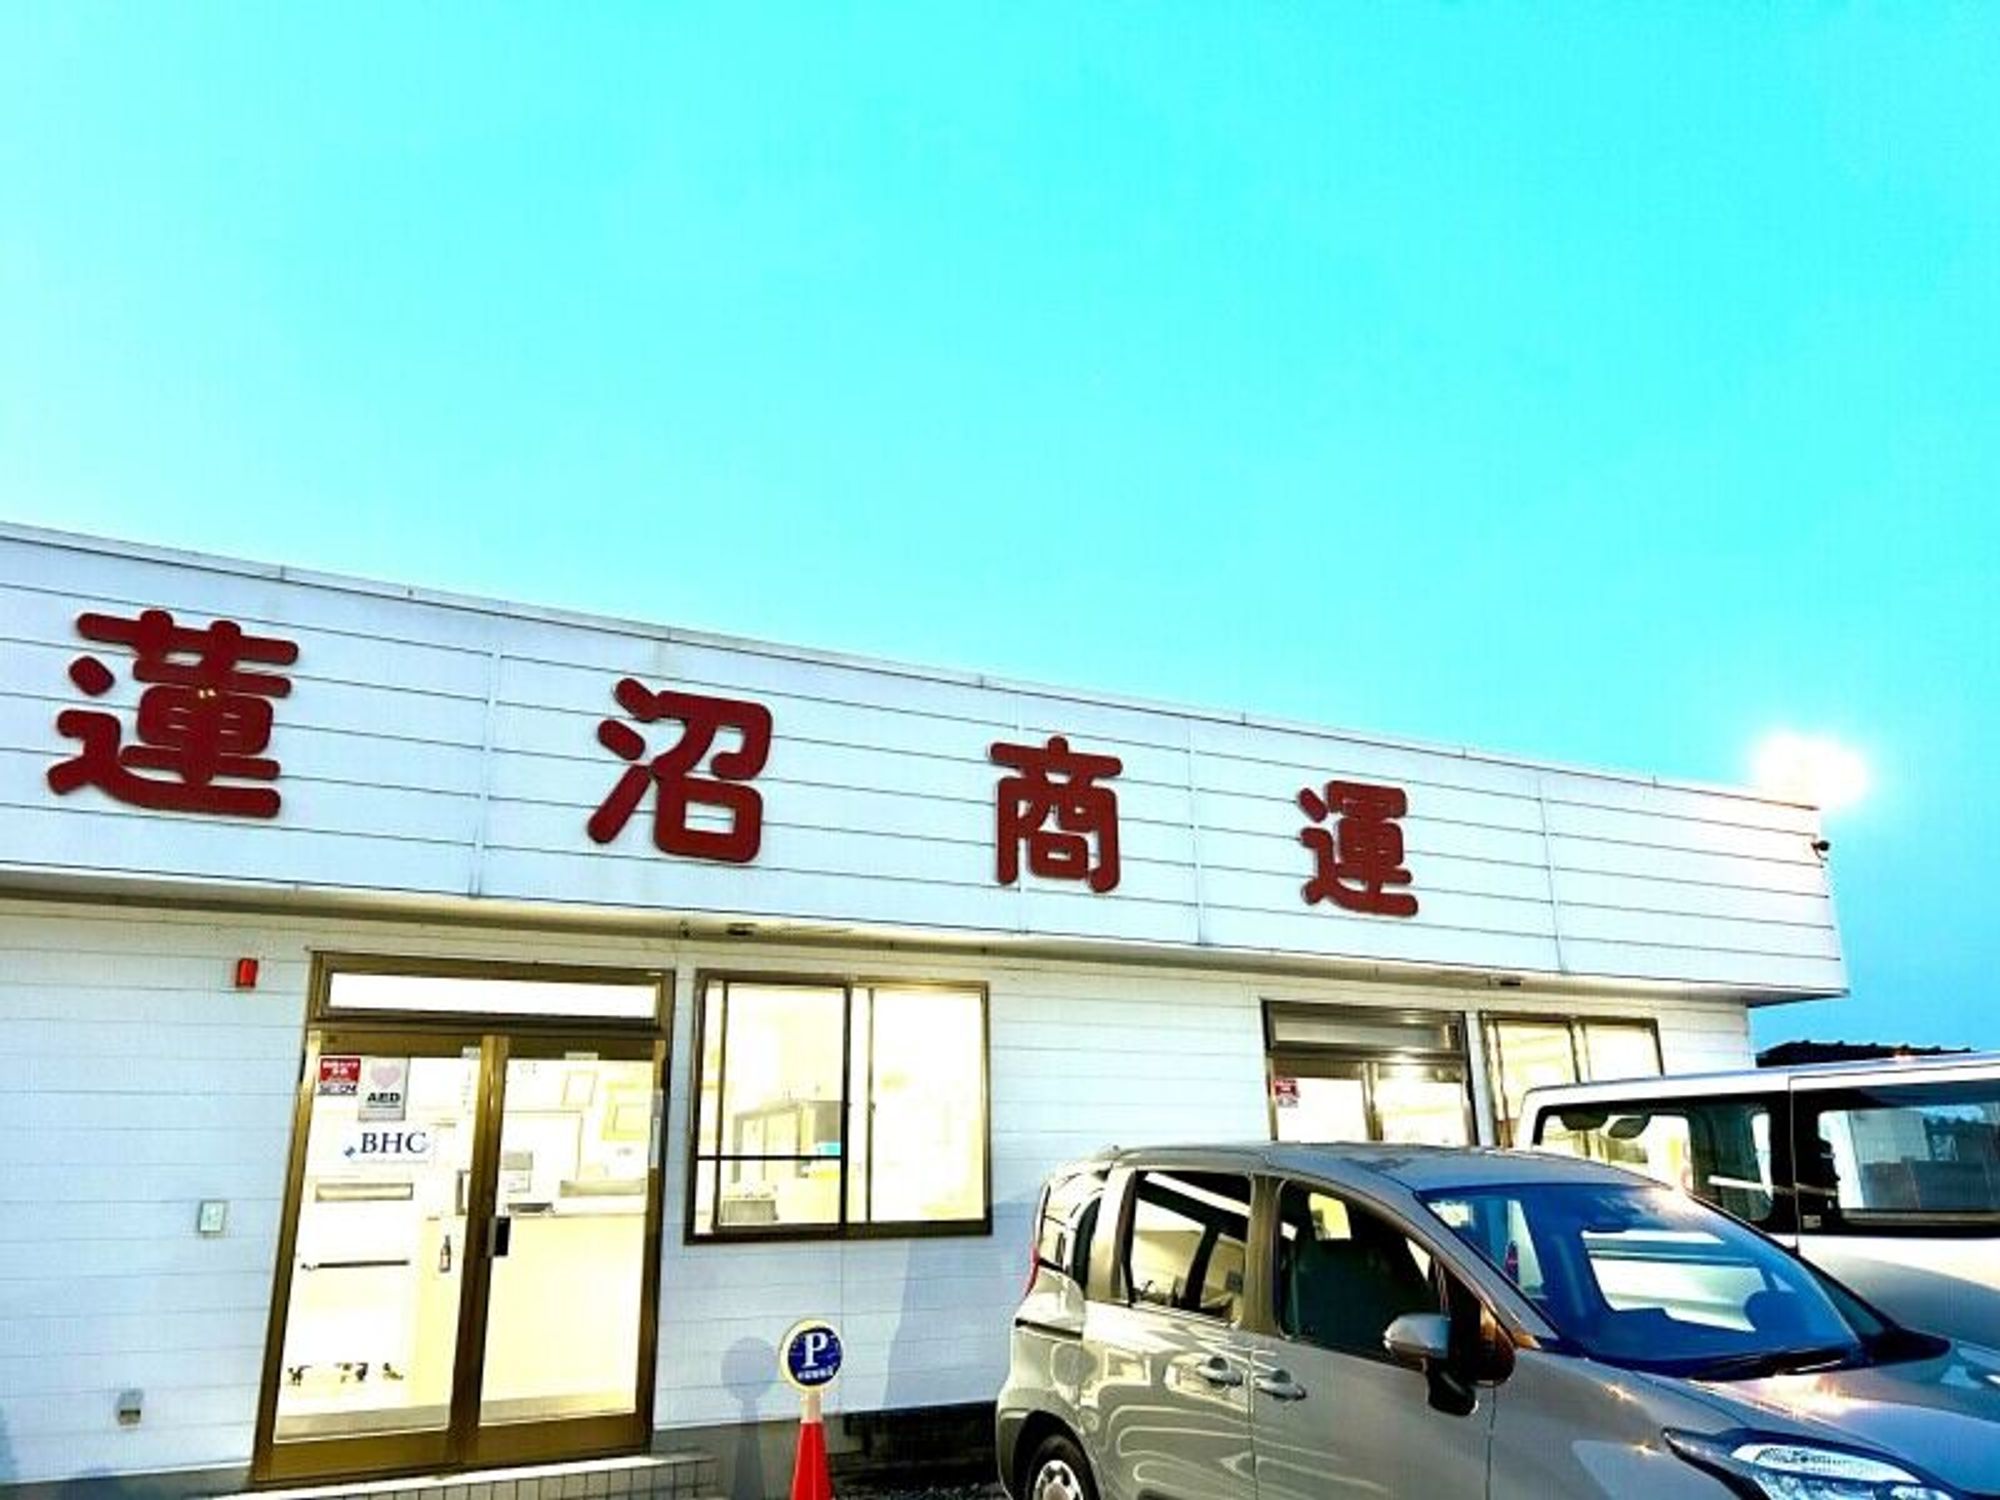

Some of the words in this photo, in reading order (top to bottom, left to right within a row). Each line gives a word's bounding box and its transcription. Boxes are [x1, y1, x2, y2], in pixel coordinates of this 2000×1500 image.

[46, 608, 1419, 918] 蓮沼商運
[367, 1092, 401, 1103] AED
[360, 1132, 428, 1154] BHC
[801, 1332, 829, 1369] P
